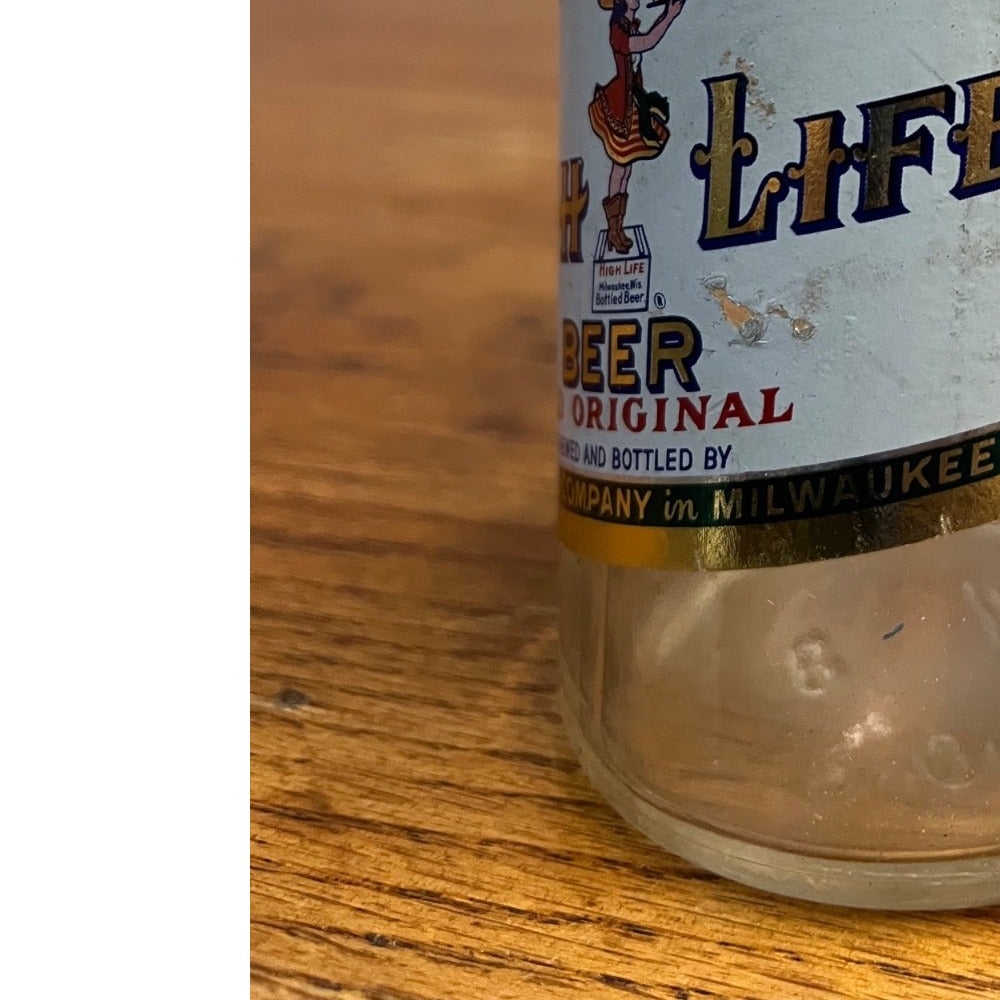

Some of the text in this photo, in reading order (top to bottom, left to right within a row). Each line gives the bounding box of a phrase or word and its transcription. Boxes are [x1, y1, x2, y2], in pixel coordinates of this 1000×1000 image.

[598, 260, 645, 277] HIGH LIFE
[595, 290, 645, 306] Bottled Beer
[562, 315, 703, 394] BEER
[571, 387, 795, 433] ORIGINAL
[583, 442, 607, 468] AND
[611, 446, 694, 471] BOTTLED
[703, 444, 733, 470] BY
[663, 488, 699, 521] in
